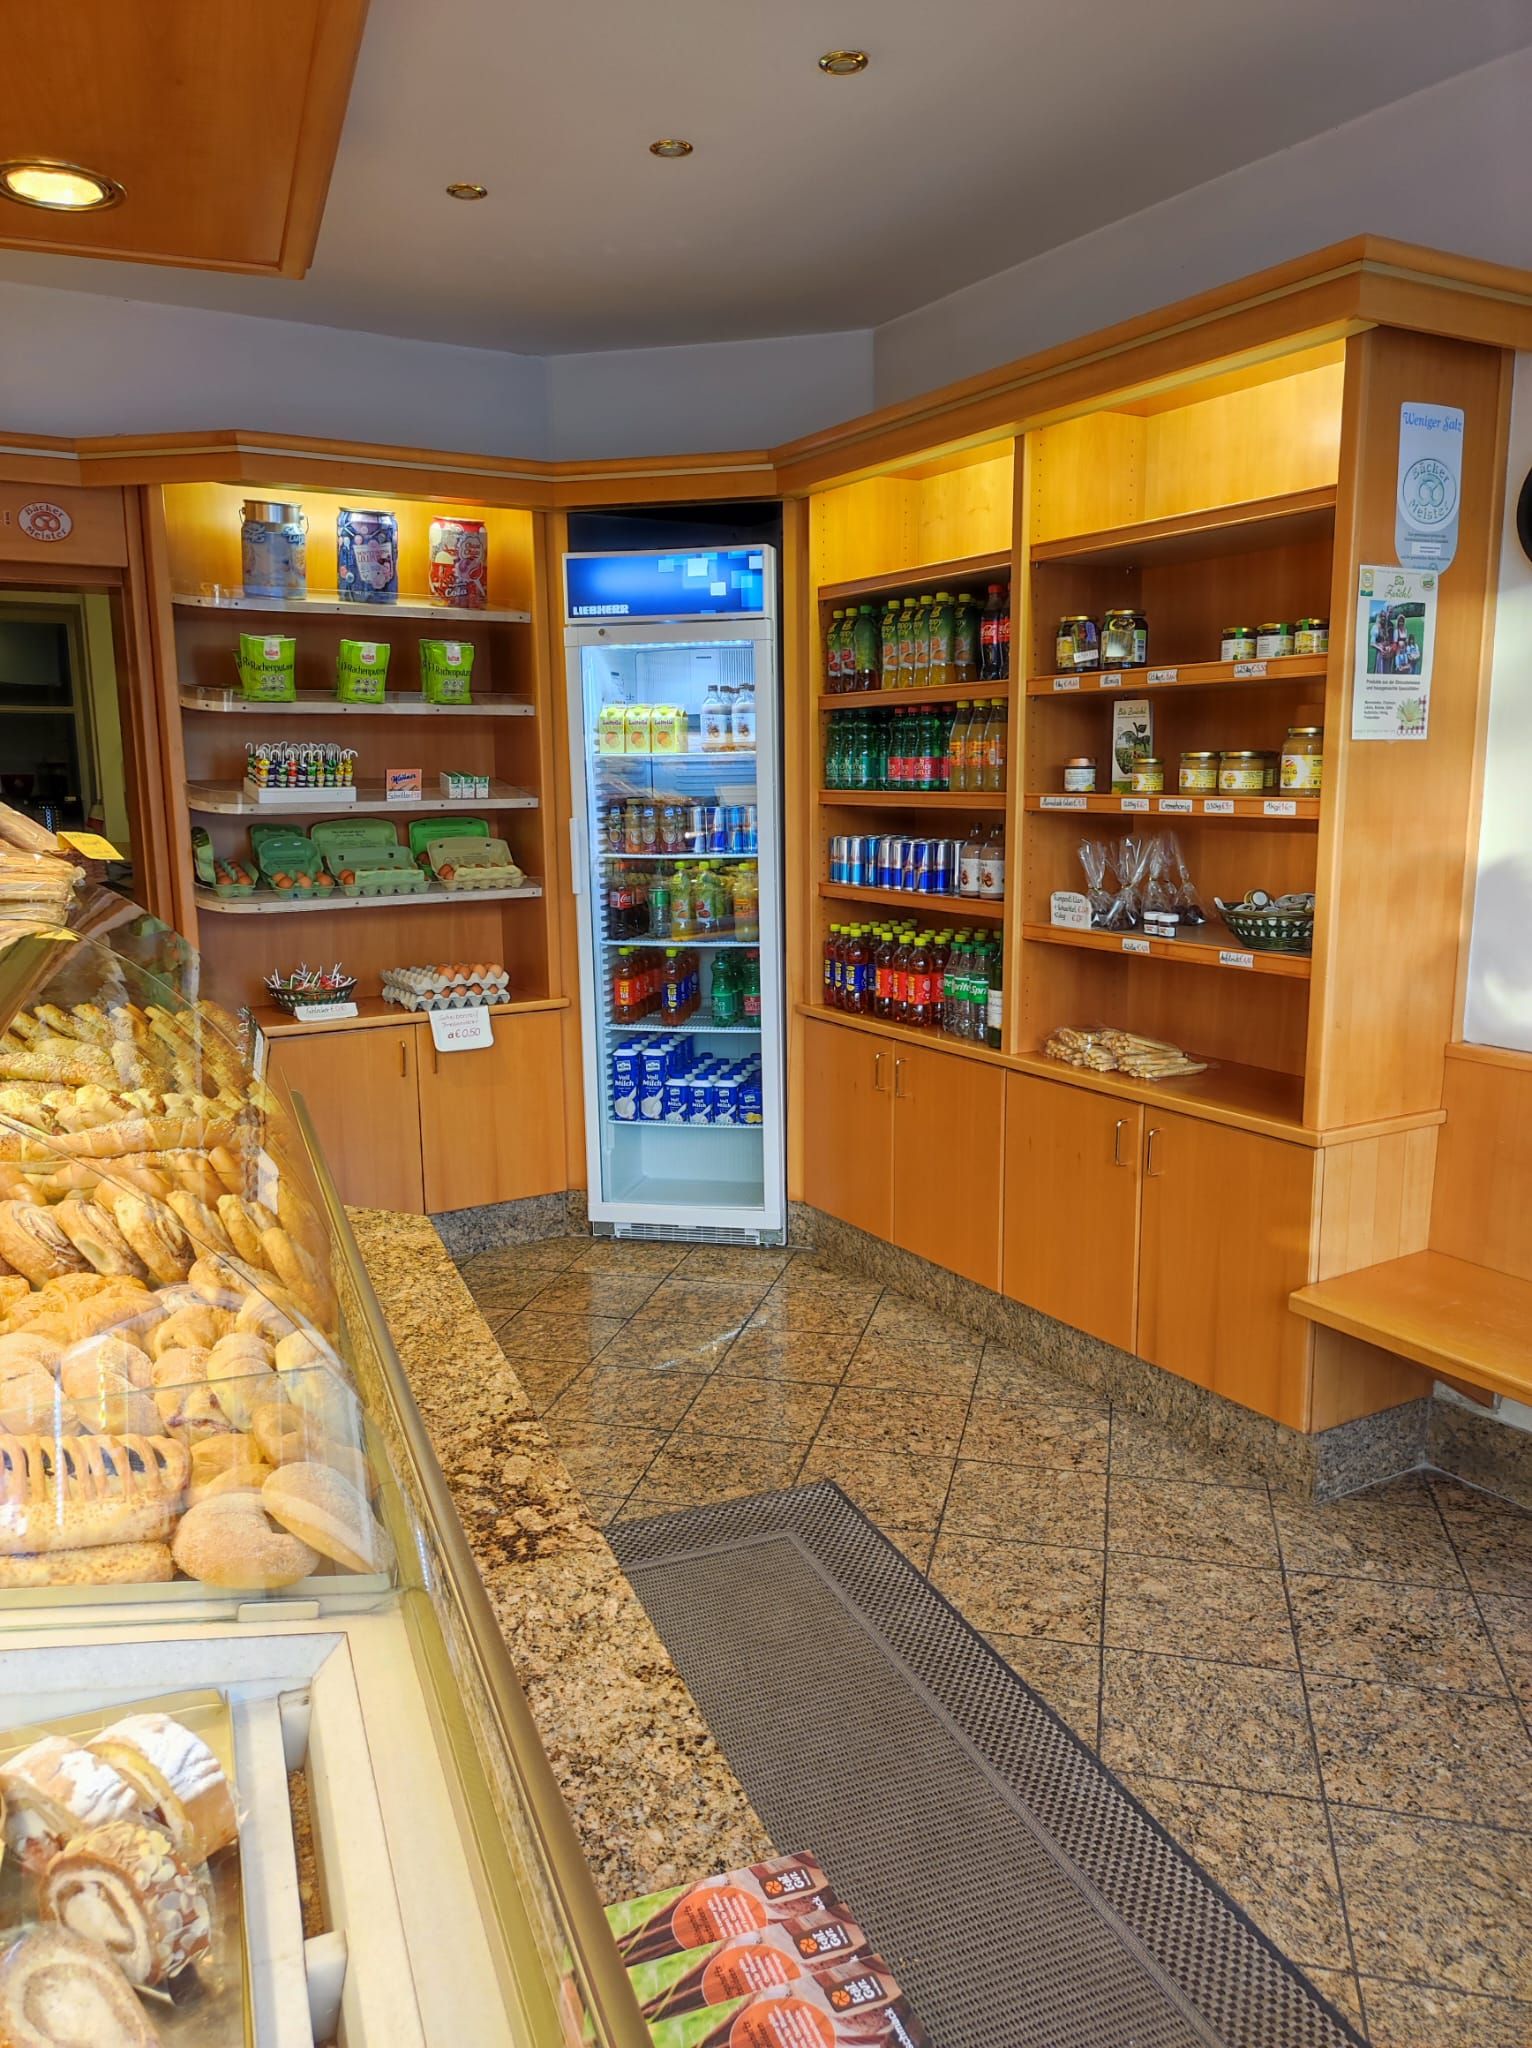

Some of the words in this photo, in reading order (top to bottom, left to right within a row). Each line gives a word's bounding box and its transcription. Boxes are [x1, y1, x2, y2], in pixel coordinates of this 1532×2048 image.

[1403, 412, 1441, 430] Weniger
[1443, 416, 1463, 432] Salz
[1412, 462, 1450, 482] Bäcker
[25, 504, 65, 518] Bäcker
[1408, 498, 1449, 520] Meister
[26, 526, 67, 540] Meister
[572, 604, 630, 616] LIEBHERR
